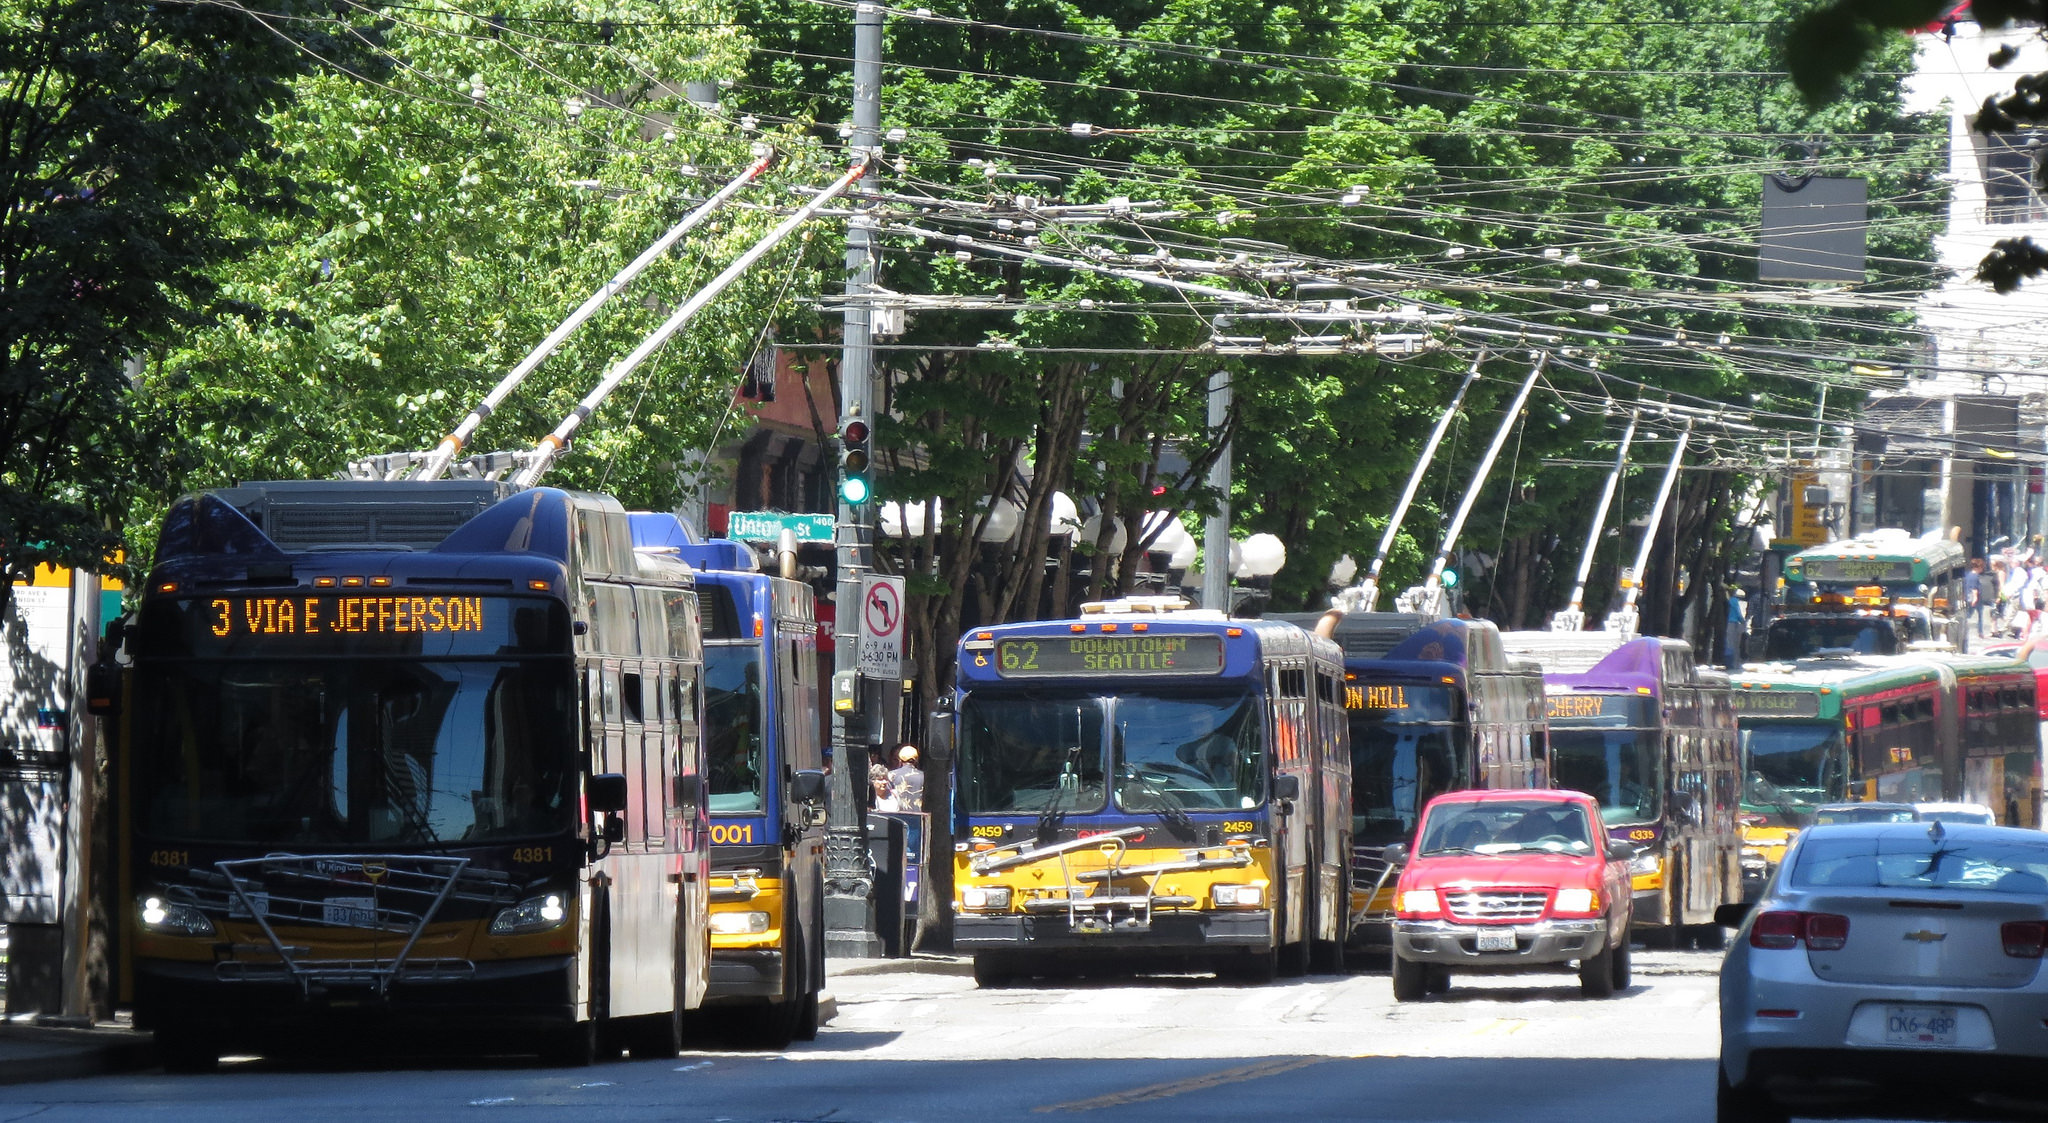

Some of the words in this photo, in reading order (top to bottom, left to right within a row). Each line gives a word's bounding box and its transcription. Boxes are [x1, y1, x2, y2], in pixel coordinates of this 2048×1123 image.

[797, 522, 811, 537] St
[212, 599, 230, 636] 3
[245, 599, 294, 633] VIA
[305, 598, 319, 633] E
[330, 597, 481, 632] JEFFERSON
[865, 641, 878, 650] 6-9
[882, 642, 893, 650] AM
[1070, 637, 1187, 653] DOWNTOWN
[886, 651, 898, 663] PM
[1002, 641, 1039, 670] 62
[1083, 653, 1174, 670] SEATTLE
[1368, 686, 1409, 709] HILL
[707, 825, 753, 844] 001
[972, 826, 1003, 838] 2459
[1223, 822, 1253, 833] 2459
[150, 851, 189, 867] 4381
[513, 847, 552, 863] 4381
[328, 863, 347, 873] King
